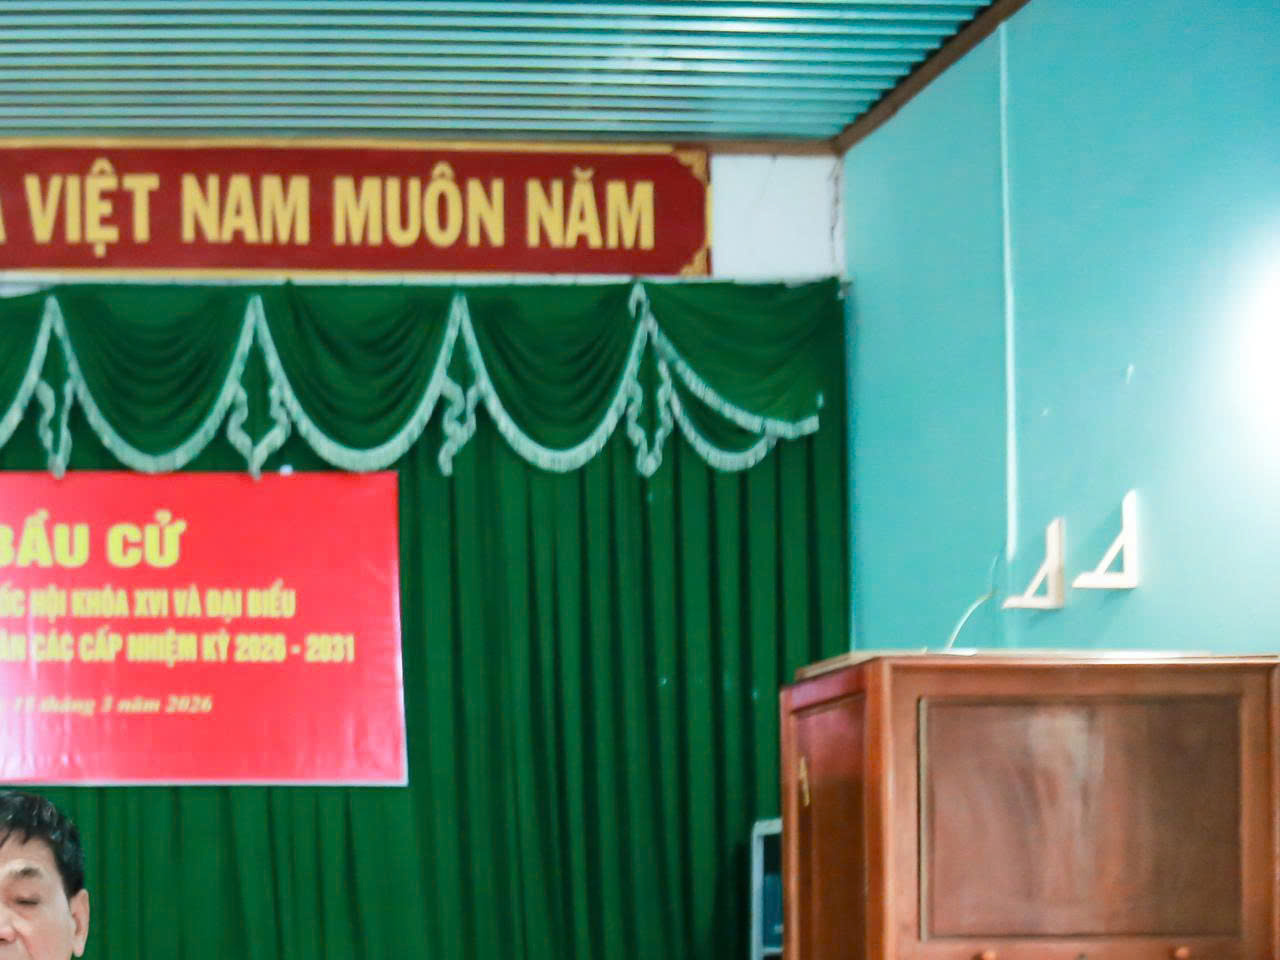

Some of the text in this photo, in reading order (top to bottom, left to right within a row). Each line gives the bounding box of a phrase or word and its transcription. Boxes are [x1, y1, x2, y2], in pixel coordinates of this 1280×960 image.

[23, 159, 160, 257] VIỆT
[181, 174, 311, 246] NAM
[332, 161, 505, 249] MUÔN
[526, 167, 655, 250] NĂM
[107, 508, 188, 569] CỬ
[134, 587, 169, 618] XVI
[31, 627, 75, 662] CÁC
[78, 623, 123, 662] CẤP
[305, 633, 356, 662] 2031
